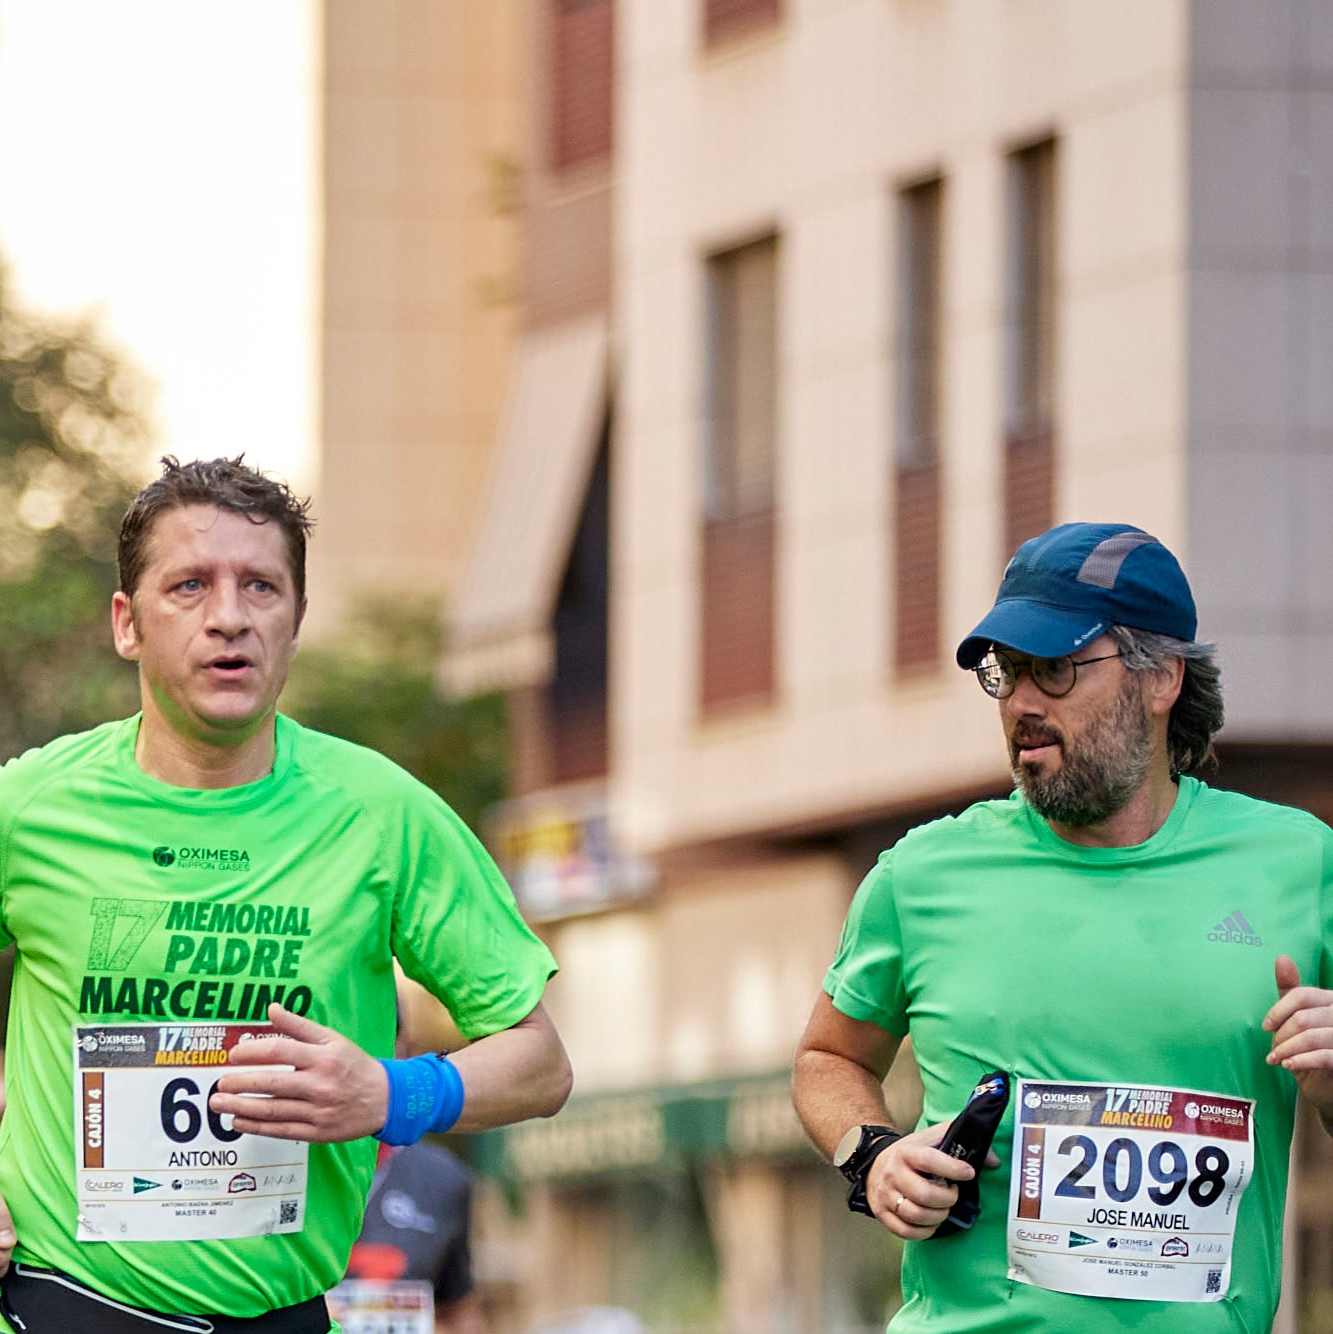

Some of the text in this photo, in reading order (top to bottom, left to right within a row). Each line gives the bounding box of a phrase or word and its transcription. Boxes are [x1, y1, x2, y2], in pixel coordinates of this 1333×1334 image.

[179, 848, 250, 862] OXIMESA
[178, 861, 251, 872] NIPPON GASES
[87, 897, 312, 971] 17 MEMORIAL
[1207, 929, 1262, 947] adidas
[164, 934, 304, 979] PADRE
[79, 976, 313, 1020] MARCELINO
[99, 1034, 145, 1045] OXIMESA
[158, 1027, 226, 1051] 17 MEMORIAL
[183, 1037, 223, 1050] PADRE
[155, 1050, 227, 1065] MARCELINO
[1042, 1089, 1173, 1112] OXIMESA 17 MEMORIAL
[1129, 1099, 1169, 1115] PADRE
[86, 1088, 102, 1148] CAJÓN 4
[1201, 1104, 1244, 1119] OXIMESA
[1100, 1111, 1173, 1129] MARCELINO
[168, 1150, 238, 1167] ANTONIO
[1024, 1144, 1041, 1199] CAJÓN 4
[1054, 1134, 1230, 1208] 2098
[87, 1181, 124, 1189] CALERO
[184, 1178, 219, 1186] OXIMESA
[1087, 1208, 1190, 1231] JOSE MANUEL
[1019, 1231, 1060, 1242] CALERO
[1119, 1238, 1154, 1247] OXIMESA
[1108, 1268, 1139, 1277] MASTER
